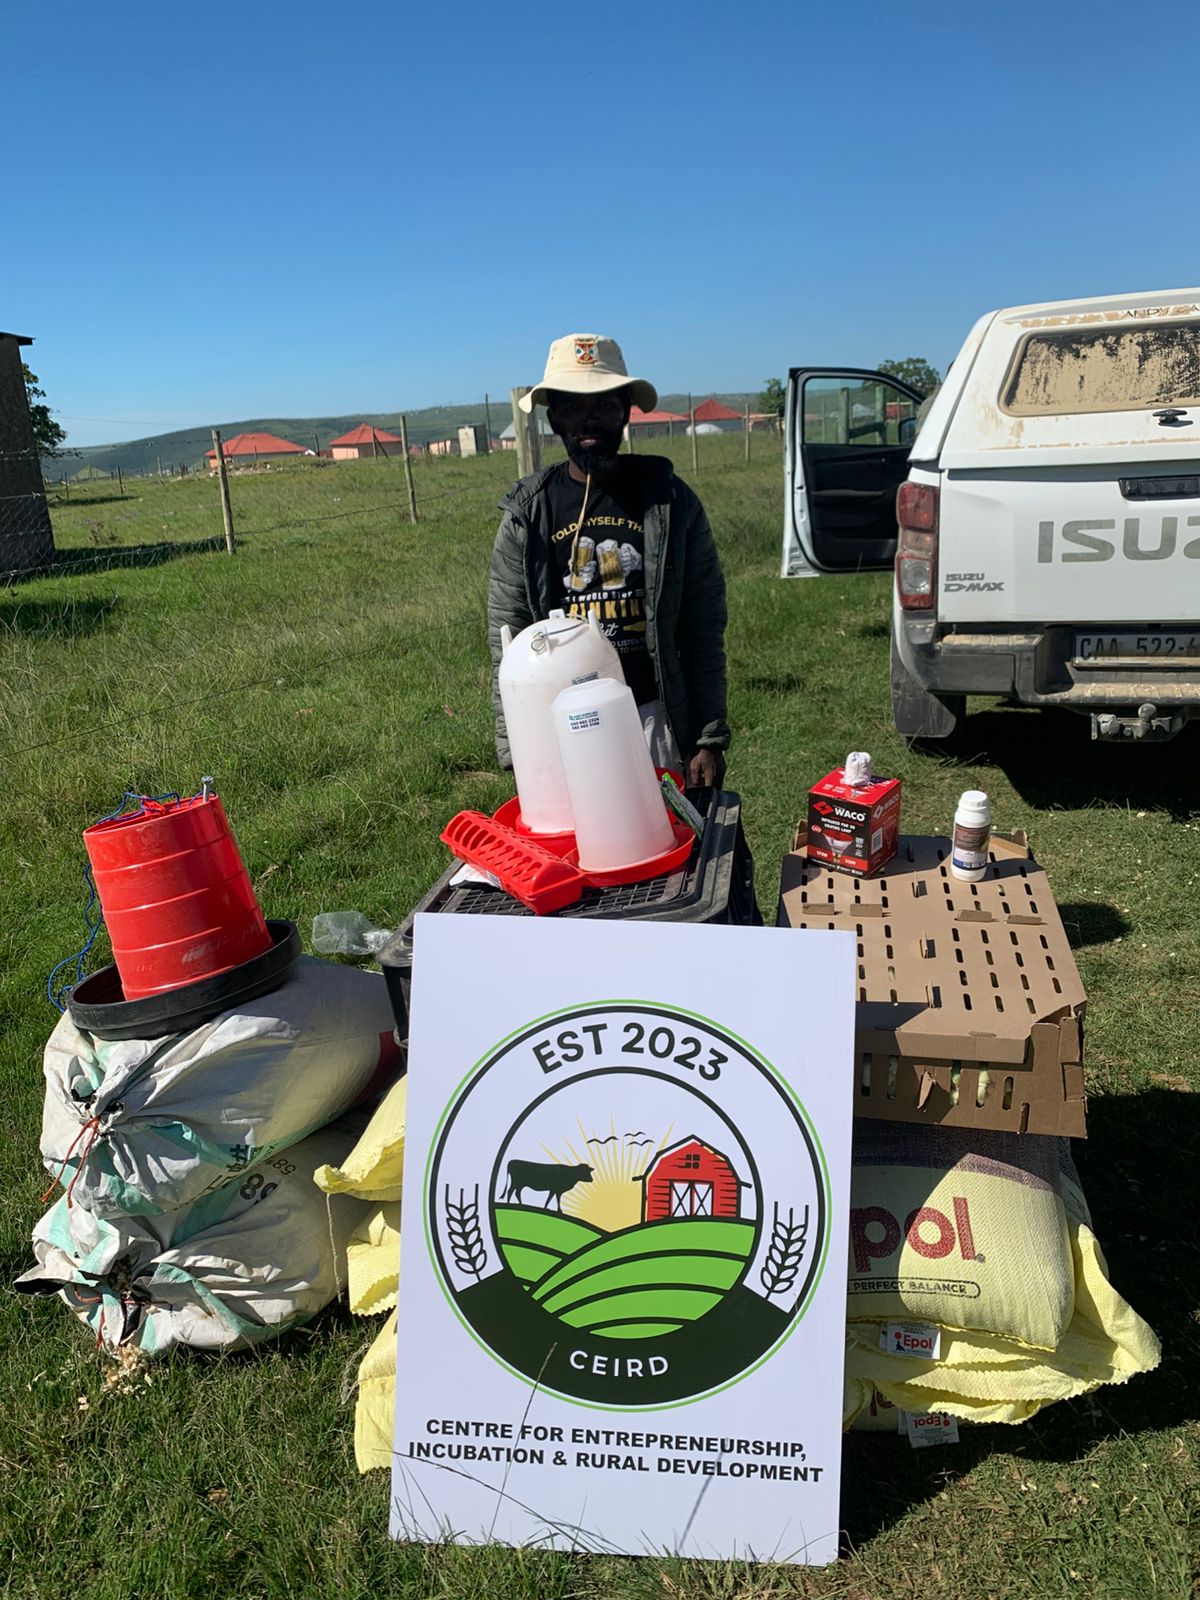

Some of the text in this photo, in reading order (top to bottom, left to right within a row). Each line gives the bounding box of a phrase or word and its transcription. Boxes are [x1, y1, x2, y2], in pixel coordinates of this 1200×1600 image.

[946, 573, 985, 581] ISUZU
[943, 581, 1005, 592] D-MAX
[1081, 637, 1118, 660] CAA
[834, 807, 865, 822] WACO
[532, 1022, 729, 1081] EST 2023
[854, 1281, 905, 1292] PERFECT
[909, 1282, 967, 1294] BALANCE
[903, 1334, 933, 1350] Epol
[569, 1349, 670, 1379] CEIRD
[913, 1414, 942, 1429] Epol
[426, 1419, 807, 1461] CENTRE FOR ENTREPRENEURSHIP,
[408, 1441, 824, 1483] INCUBATION & RURAL DEVELOPMENT
